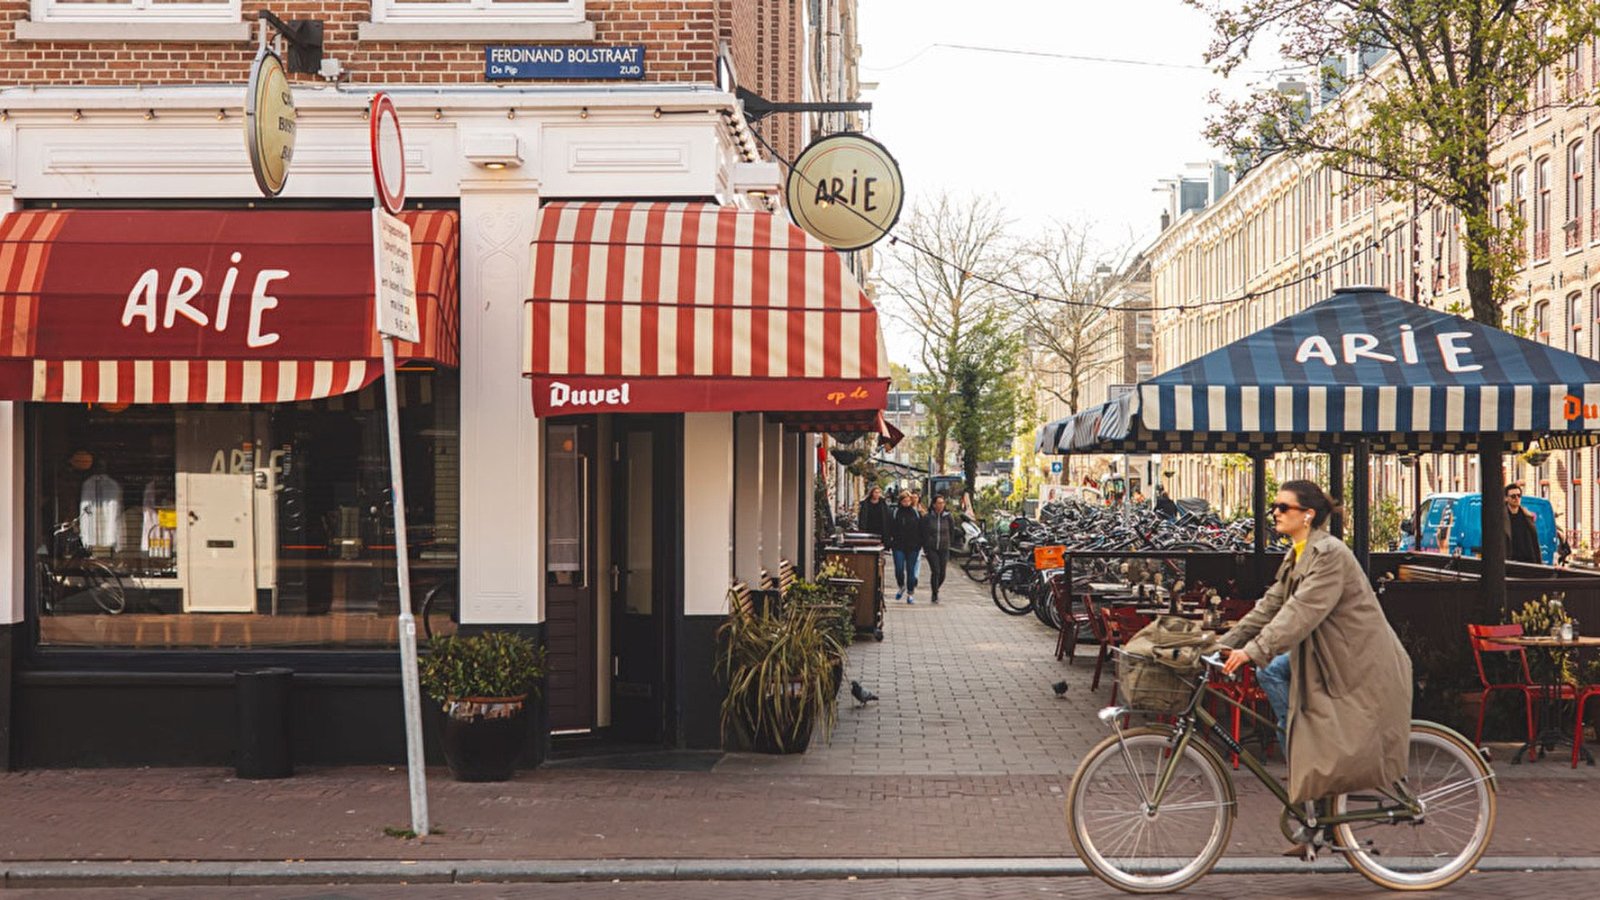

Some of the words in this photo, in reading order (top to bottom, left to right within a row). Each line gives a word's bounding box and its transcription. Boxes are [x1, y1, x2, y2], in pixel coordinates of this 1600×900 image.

[491, 48, 564, 63] FERDINAND
[568, 48, 638, 63] BOLSTRAAT
[491, 65, 502, 74] De
[505, 65, 518, 75] Pijp
[620, 65, 640, 75] ZUID
[549, 381, 631, 407] Duvel
[827, 392, 846, 405] op
[850, 386, 869, 399] de
